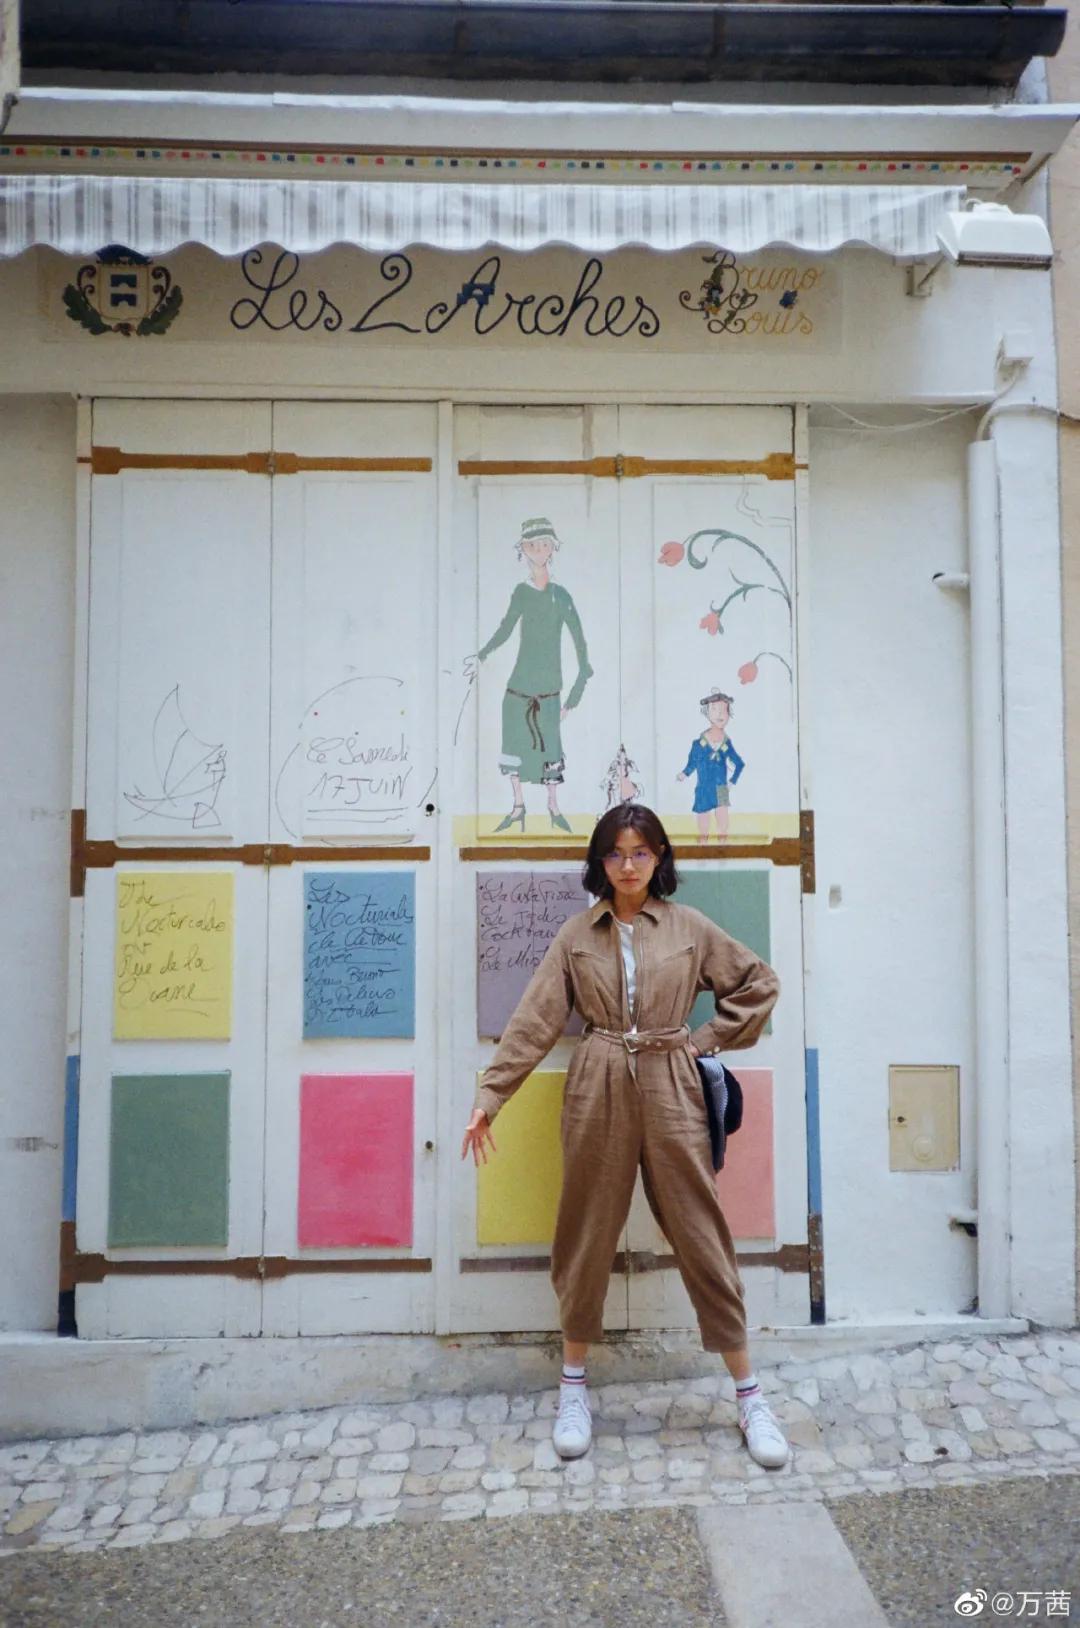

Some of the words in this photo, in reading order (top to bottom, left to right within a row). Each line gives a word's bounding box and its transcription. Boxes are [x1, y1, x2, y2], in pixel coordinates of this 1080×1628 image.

[231, 249, 342, 333] Les
[350, 253, 421, 333] 2
[425, 255, 660, 338] Arches
[308, 772, 345, 799] 17
